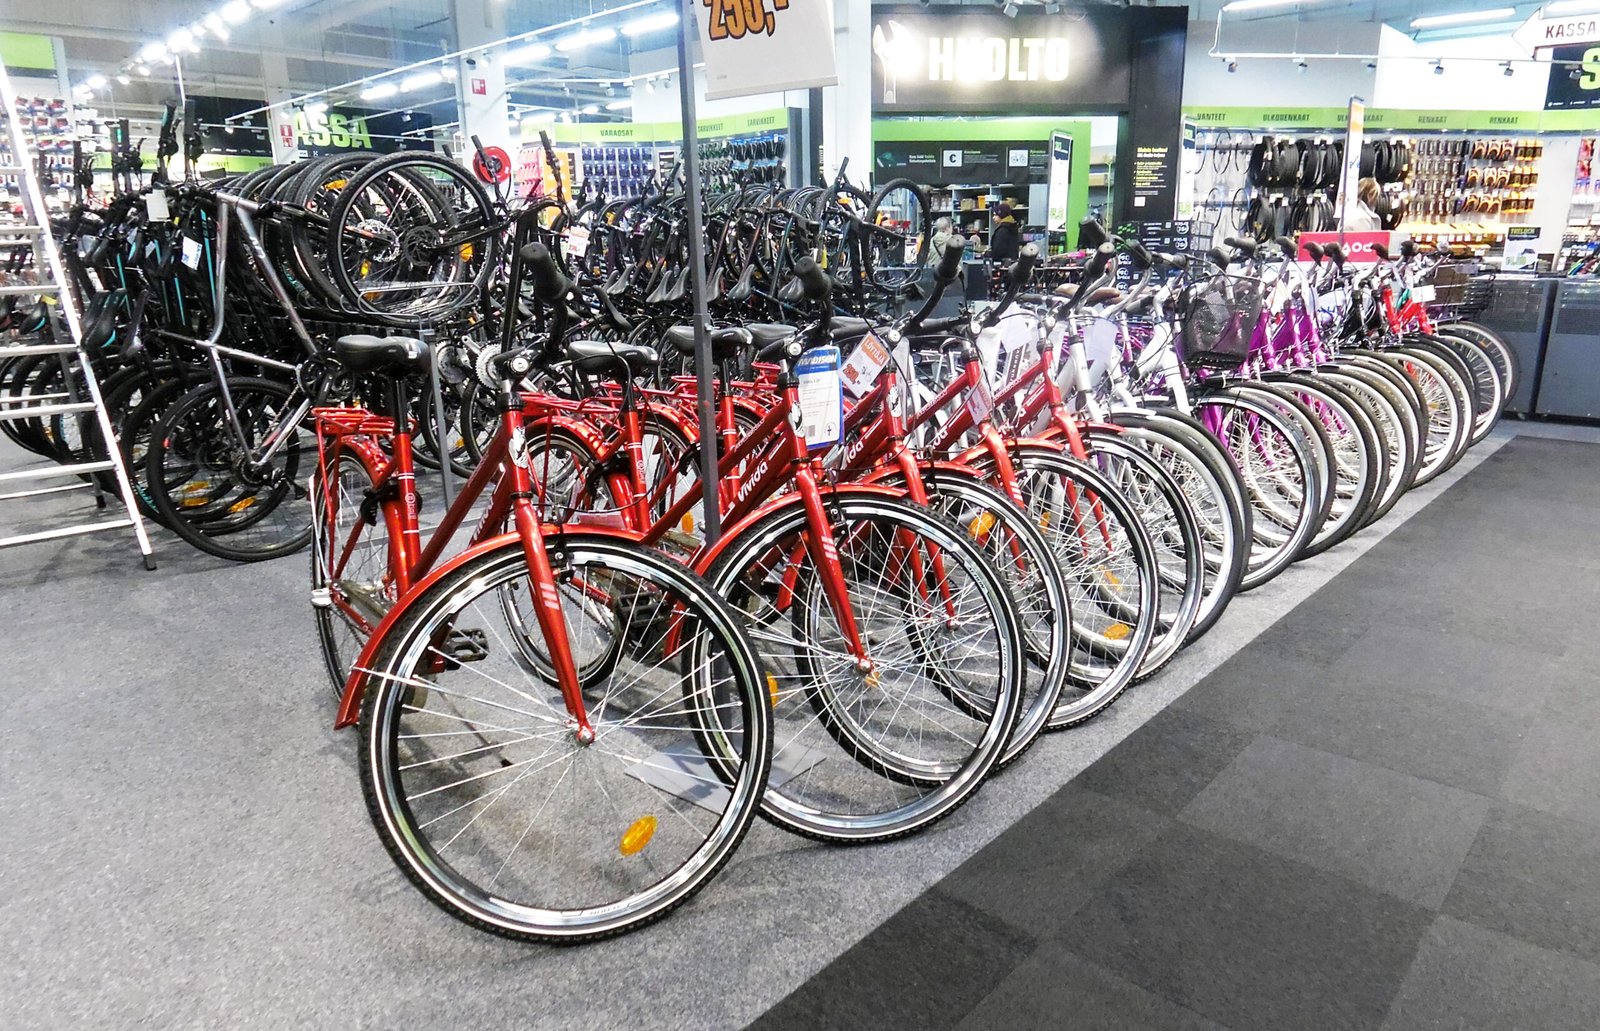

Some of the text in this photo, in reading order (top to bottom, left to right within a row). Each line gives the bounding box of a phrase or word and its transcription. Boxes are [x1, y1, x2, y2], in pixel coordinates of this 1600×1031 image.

[1545, 21, 1596, 39] KASSA
[747, 116, 775, 127] TARVIKKEET
[1197, 113, 1226, 121] VANTEET
[600, 129, 634, 137] VARAOSAT
[798, 352, 838, 367] MADISON
[737, 460, 769, 502] Vivida
